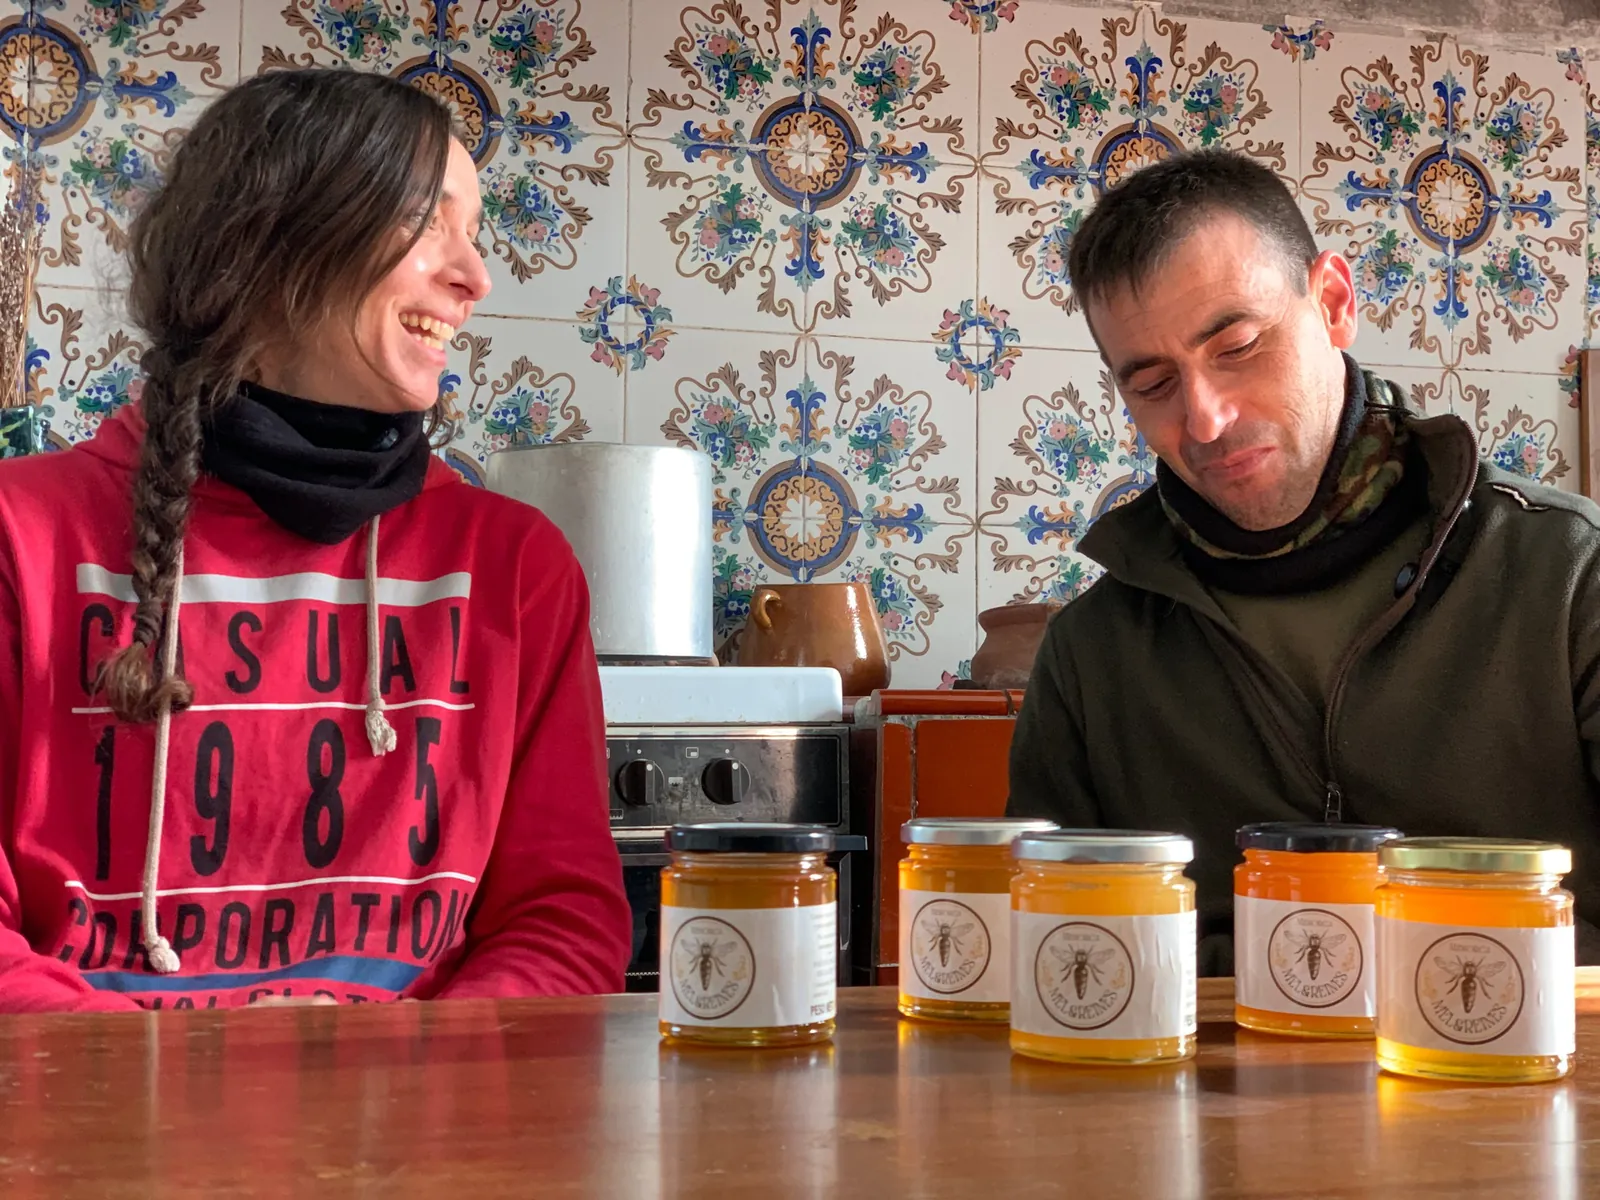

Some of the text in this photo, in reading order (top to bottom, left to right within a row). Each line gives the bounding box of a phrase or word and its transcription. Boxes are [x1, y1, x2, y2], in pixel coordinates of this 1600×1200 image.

[94, 717, 442, 881] 1985
[58, 887, 469, 971] CORPORATION
[1282, 968, 1348, 999] MEL&REINES
[1431, 1000, 1507, 1034] MEL&REINES
